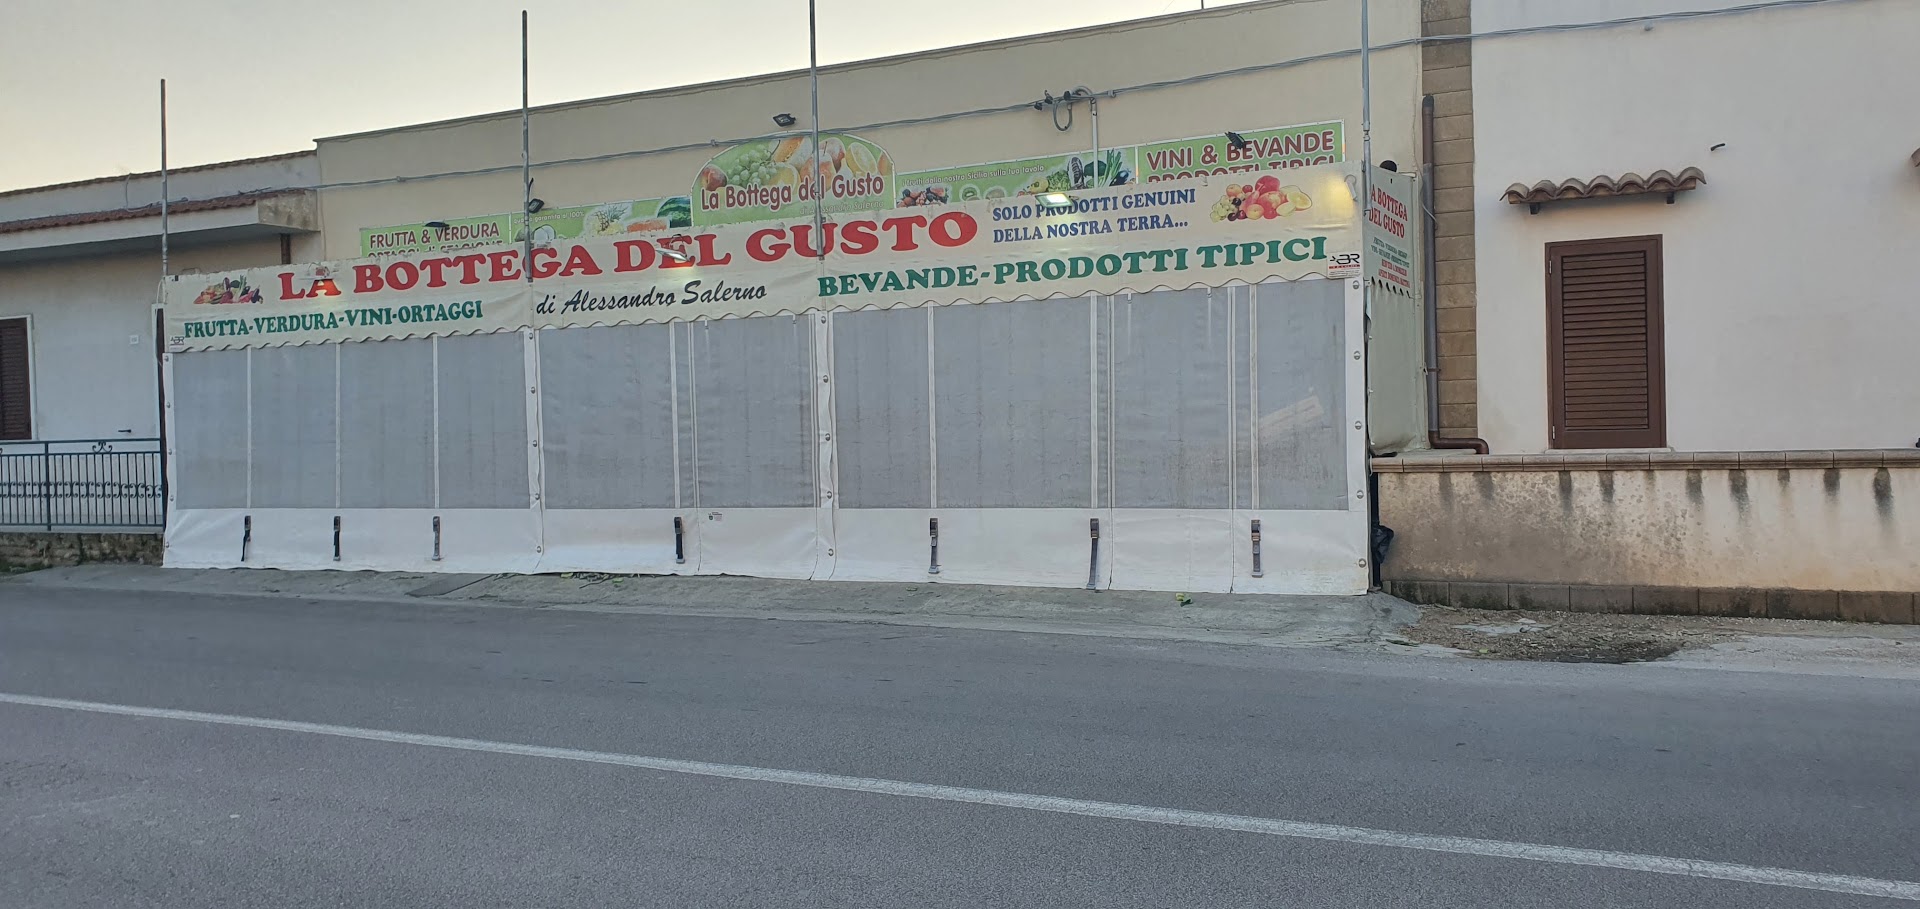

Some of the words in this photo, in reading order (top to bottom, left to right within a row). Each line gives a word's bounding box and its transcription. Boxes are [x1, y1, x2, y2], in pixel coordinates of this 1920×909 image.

[1146, 147, 1192, 170] VINI
[1200, 144, 1218, 165] &
[1227, 130, 1334, 162] BEVANDE
[701, 188, 719, 210] La
[725, 183, 791, 211] Bottega
[832, 172, 884, 198] Gusto
[967, 172, 987, 180] Sicilia
[990, 169, 1006, 177] sulla
[854, 200, 883, 210] Salerno
[992, 204, 1032, 222] SOLO
[1121, 188, 1196, 210] GENUINI
[1377, 188, 1408, 222] BOTTEGA
[370, 231, 417, 249] FRUTTA
[421, 229, 431, 244] &
[435, 222, 499, 242] VERDURA
[993, 225, 1043, 243] DELLA
[1047, 219, 1112, 237] NOSTRA
[1116, 213, 1188, 232] TERRA...
[1369, 207, 1382, 227] DEL
[1383, 215, 1405, 239] GUSTO
[277, 272, 342, 300] LA
[352, 244, 603, 294] BOTTEGA
[613, 234, 731, 273] DEL
[745, 211, 978, 262] GUSTO
[817, 248, 1189, 297] BEVANDE-PRODOTTI
[1196, 236, 1328, 270] TIPICI
[536, 294, 556, 315] di
[560, 285, 677, 315] Alessandro
[681, 280, 767, 305] Salerno
[184, 300, 484, 339] FRUTTA-VERDURA-VINI-ORTAGGI
